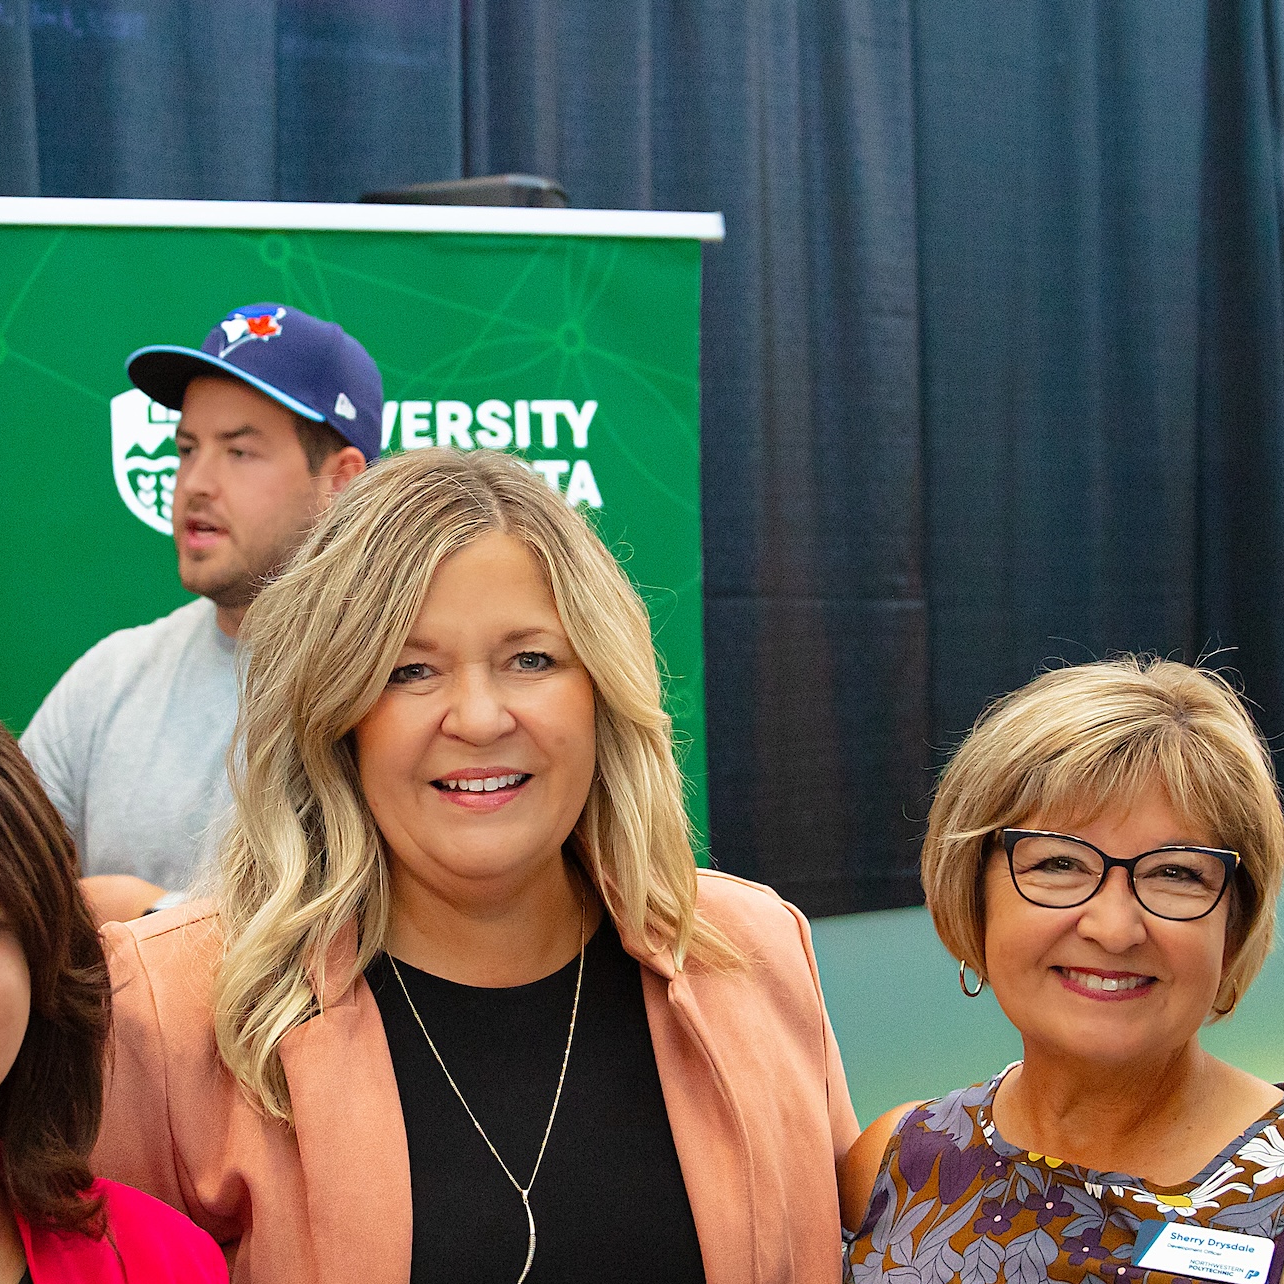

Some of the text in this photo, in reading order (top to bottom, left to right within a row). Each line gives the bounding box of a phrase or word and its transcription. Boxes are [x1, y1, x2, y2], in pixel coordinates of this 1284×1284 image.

[381, 400, 598, 449] VERSITY
[1170, 1232, 1255, 1253] Sherry Drysdale
[1188, 1265, 1234, 1277] POLYTECHNIC
[1190, 1259, 1245, 1273] NORTHWESTERN
